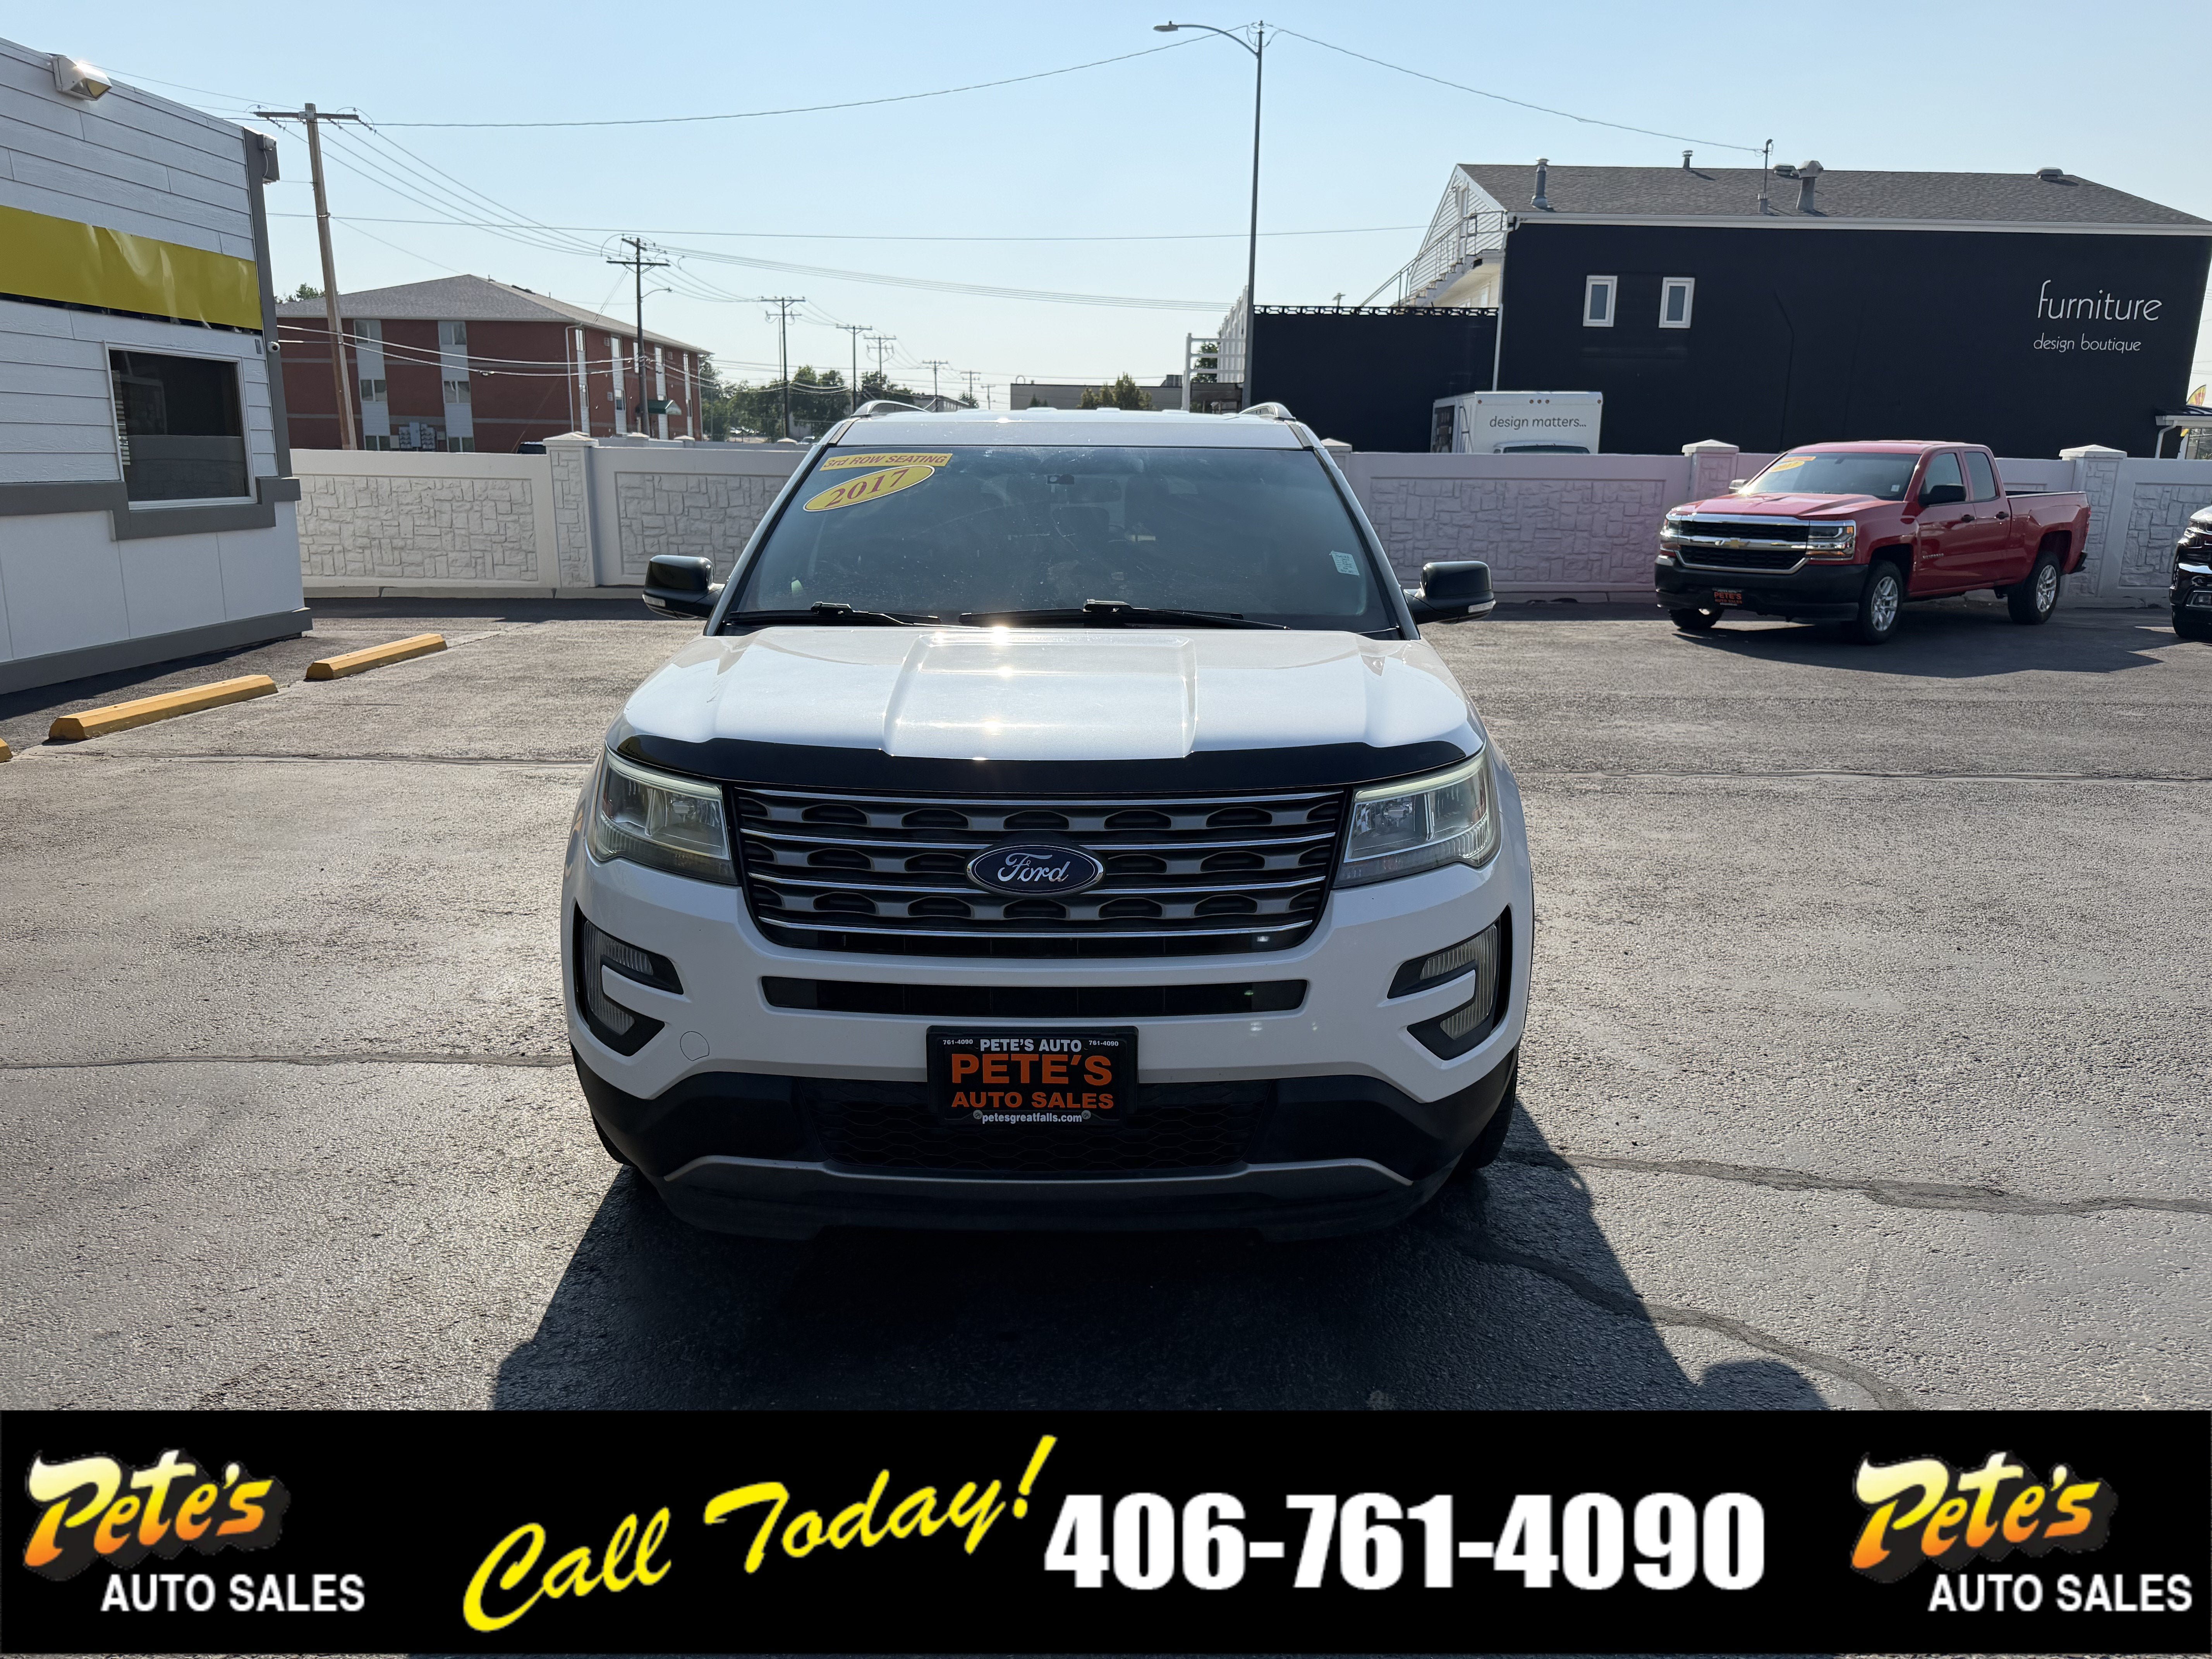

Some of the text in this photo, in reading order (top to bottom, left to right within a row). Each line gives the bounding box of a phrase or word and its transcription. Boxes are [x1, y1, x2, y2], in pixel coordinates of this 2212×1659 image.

[2037, 280, 2162, 321] furniture
[2033, 332, 2142, 354] design boutique
[1489, 415, 1587, 430] design matters...
[824, 455, 948, 468] 3rd ROW SEATING
[824, 468, 910, 508] 2017
[997, 852, 1071, 882] Ford
[980, 1039, 1082, 1052] PETE'S AUTO
[951, 1054, 1112, 1086] PETE'S
[951, 1092, 1114, 1109] AUTO SALES
[982, 1112, 1082, 1124] petesgreatfalls.com
